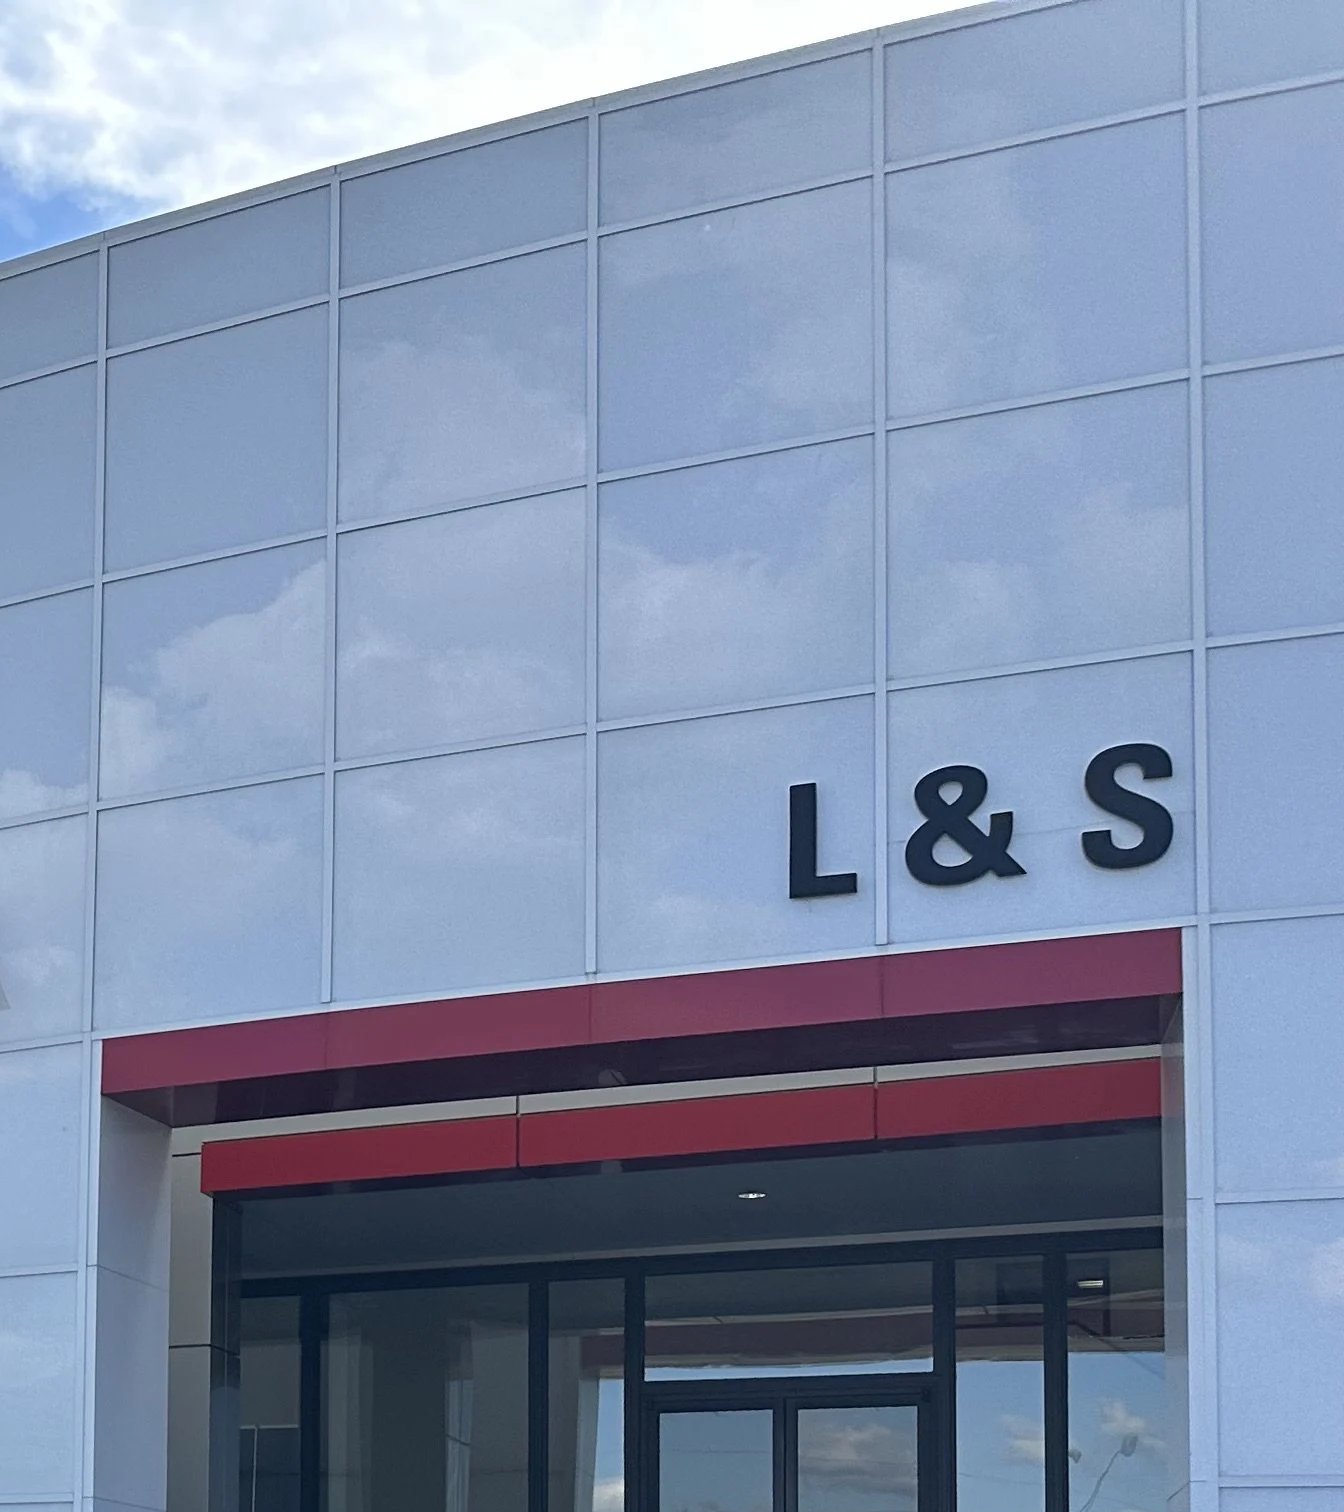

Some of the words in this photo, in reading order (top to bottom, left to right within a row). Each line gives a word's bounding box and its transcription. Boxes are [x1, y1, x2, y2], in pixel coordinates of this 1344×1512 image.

[789, 783, 858, 899] L
[905, 765, 1027, 886] &
[1082, 743, 1175, 869] S
